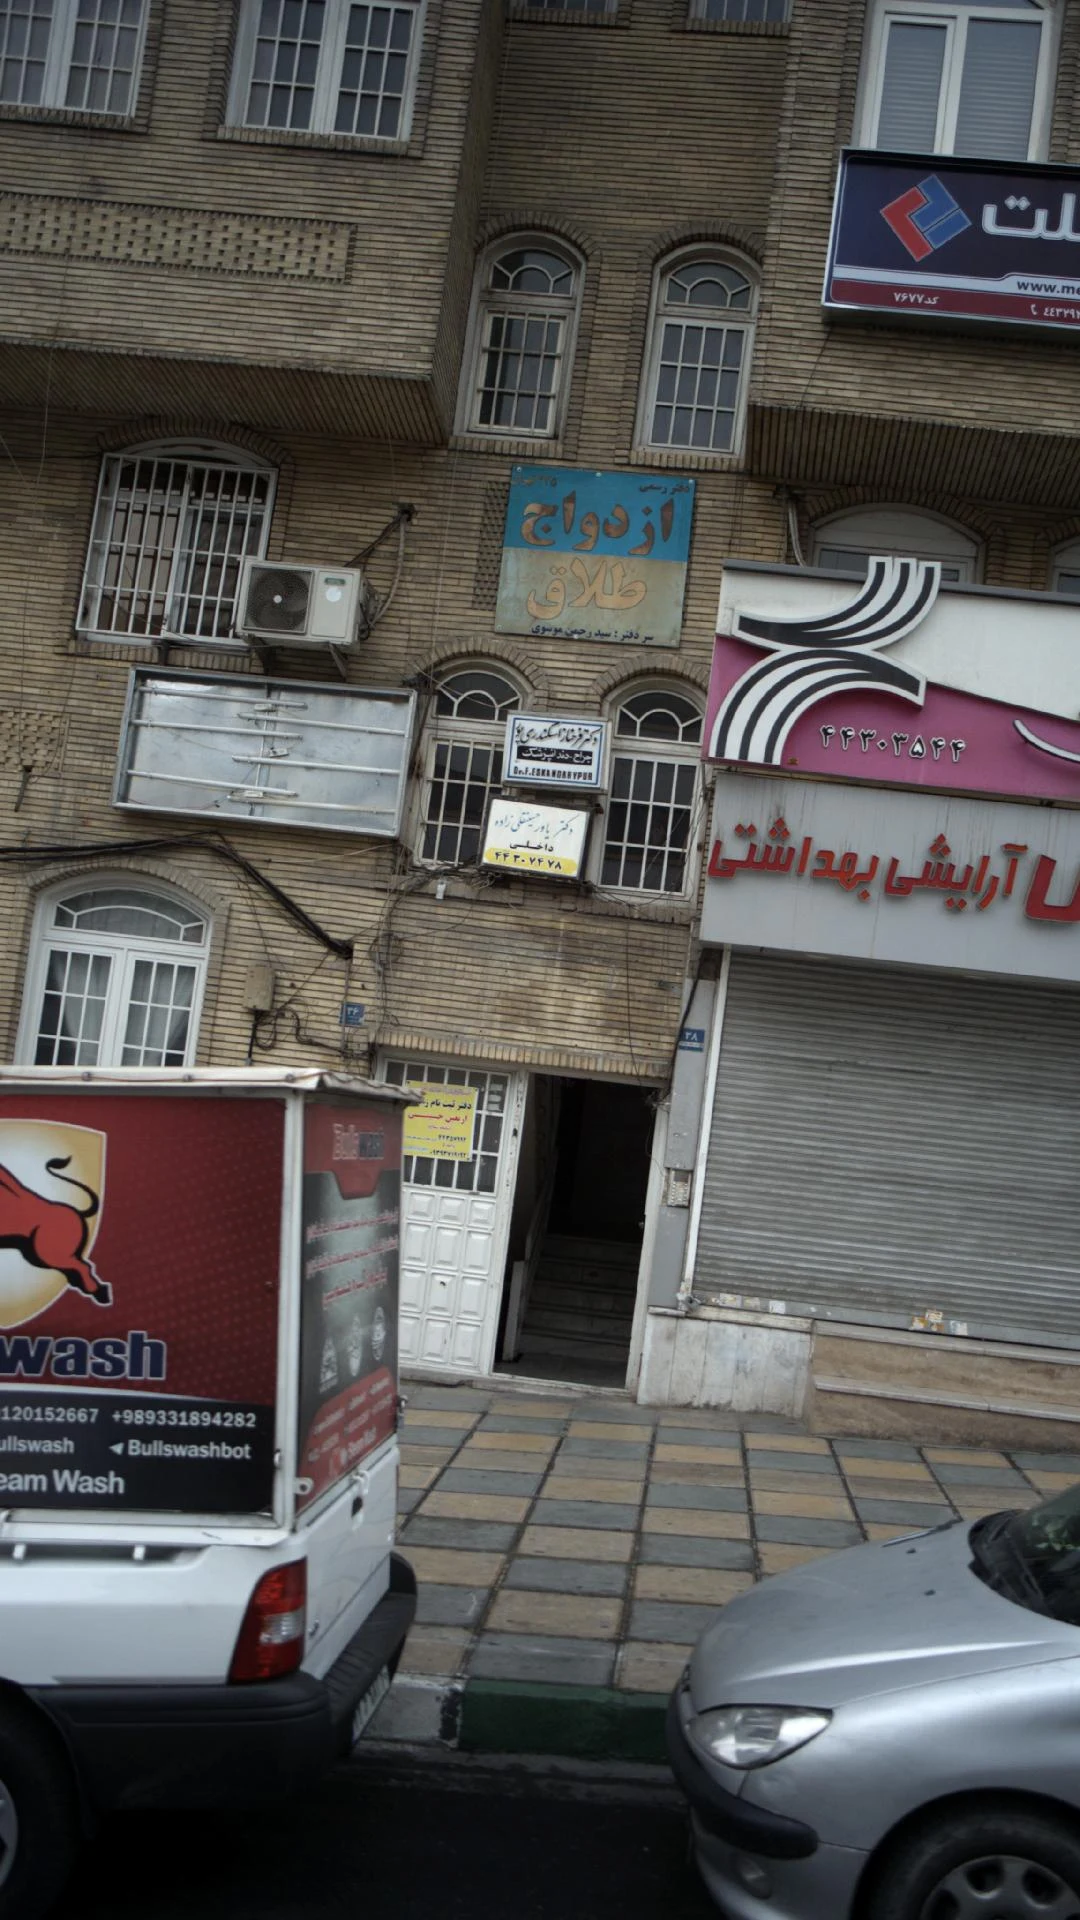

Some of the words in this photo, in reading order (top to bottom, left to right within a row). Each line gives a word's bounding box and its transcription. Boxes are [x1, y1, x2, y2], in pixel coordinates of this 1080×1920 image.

[982, 192, 1080, 242] لت
[521, 490, 675, 556] ازدواج
[526, 556, 648, 620] طلاق
[820, 724, 967, 764] ۴۴۳۰۳۵۴۴
[707, 815, 881, 903] بهداشتی
[884, 832, 1029, 911] آرایشی
[112, 1409, 256, 1429] +989331894282
[127, 1438, 251, 1460] Bullswashbot
[52, 1468, 125, 1495] Wash
